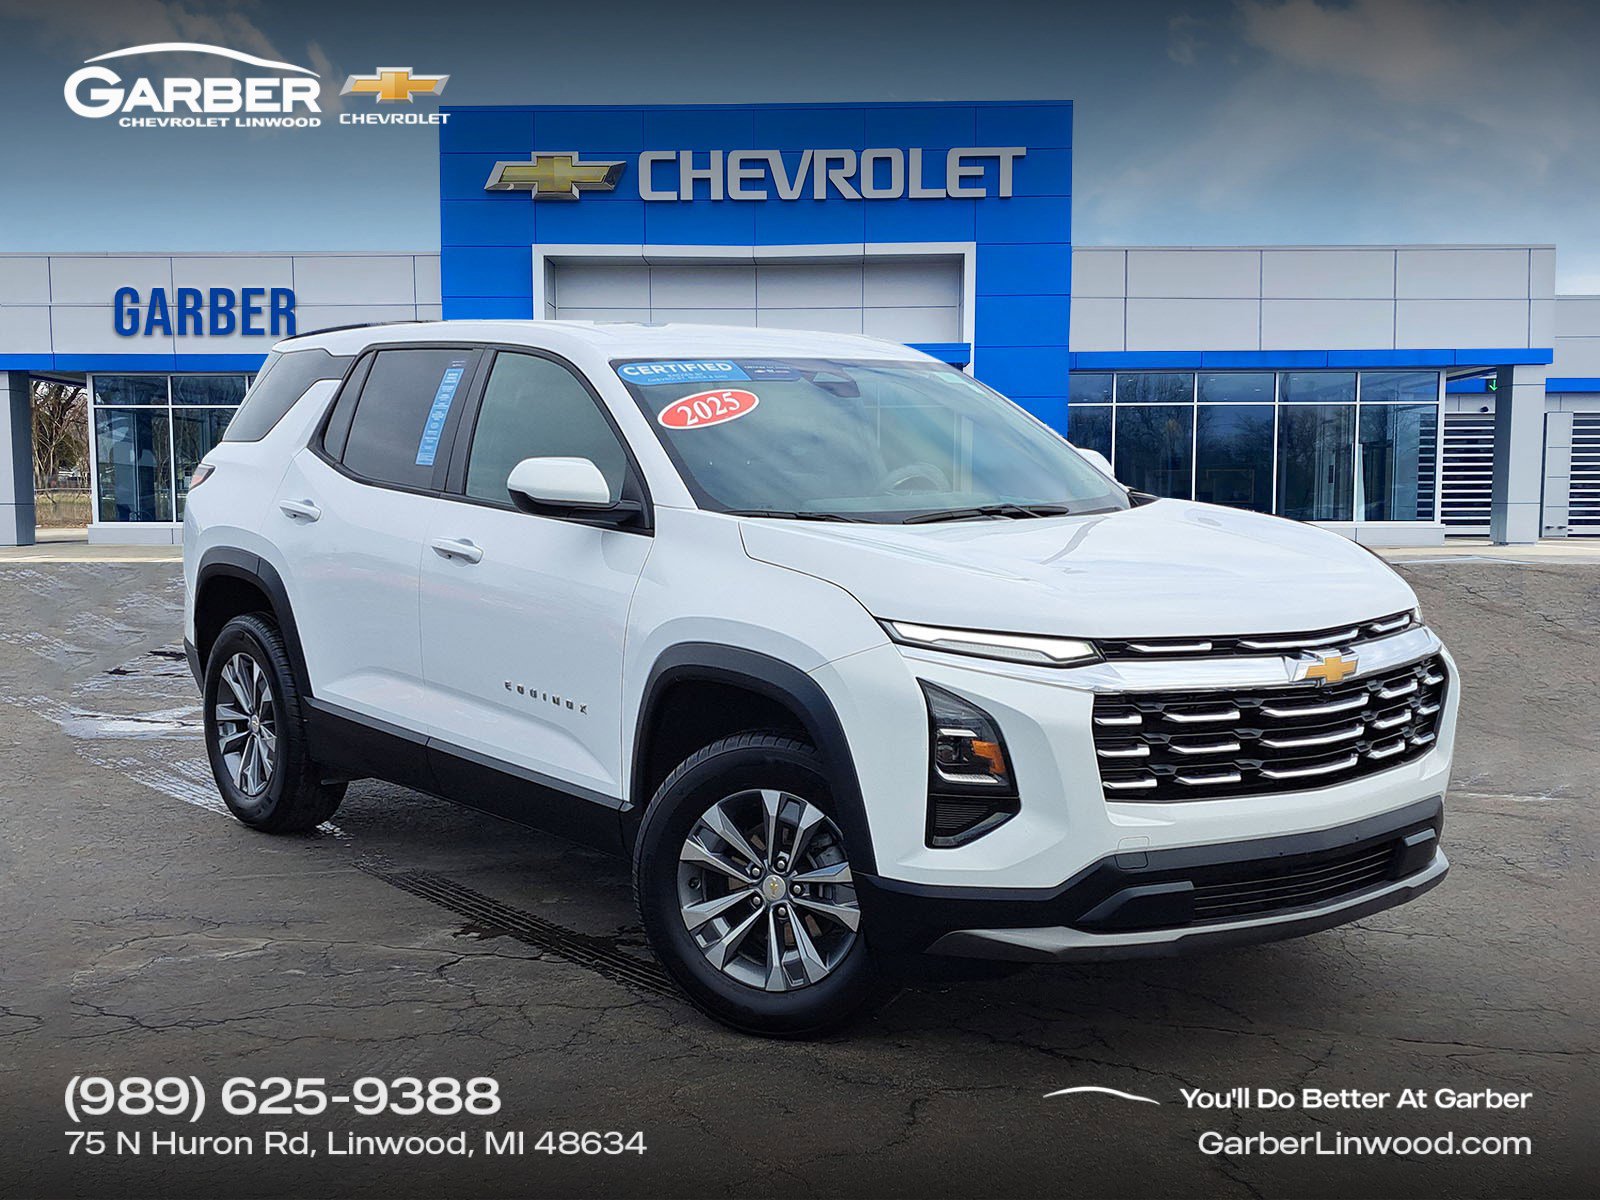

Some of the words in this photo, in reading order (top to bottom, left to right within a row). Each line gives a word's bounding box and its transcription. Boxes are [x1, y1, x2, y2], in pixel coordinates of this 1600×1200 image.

[638, 146, 1027, 202] CHEVROLET
[114, 286, 297, 337] GARBER
[623, 362, 733, 376] CERTIFIED
[676, 391, 742, 427] 2025
[503, 679, 589, 716] EQUINOX
